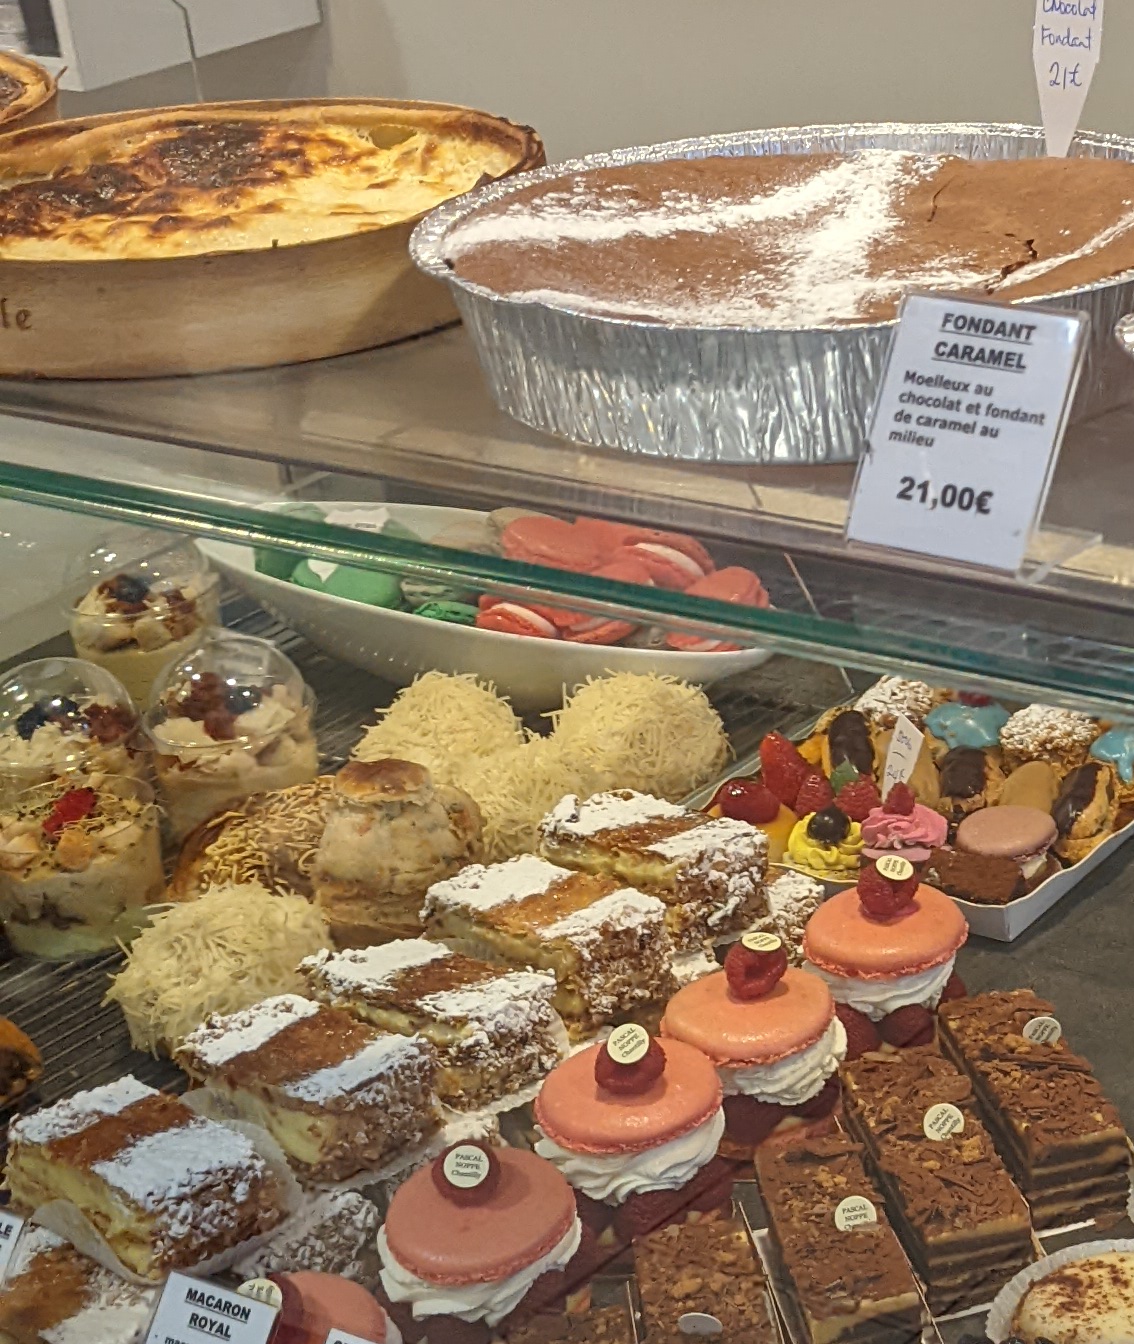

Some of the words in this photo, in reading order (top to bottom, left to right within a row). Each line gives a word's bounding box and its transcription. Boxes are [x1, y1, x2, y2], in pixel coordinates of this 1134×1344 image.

[1041, 24, 1092, 50] Fondant
[941, 312, 1037, 341] FONDANT
[934, 340, 1026, 369] CARAMEL
[903, 369, 970, 392] Moelleux
[973, 383, 993, 396] au
[898, 390, 962, 412] chocolat
[965, 402, 981, 416] et
[984, 402, 1045, 425] fondant
[893, 409, 912, 424] de
[915, 414, 976, 434] caramel
[979, 425, 999, 438] au
[888, 430, 934, 447] milieu
[896, 476, 993, 514] 21,00€
[613, 1028, 635, 1046] PASCAL
[618, 1034, 639, 1050] NOPPE
[455, 1153, 483, 1162] PASCAL
[455, 1161, 480, 1170] NOPPE
[185, 1287, 251, 1320] MACARON
[188, 1312, 231, 1338] ROYAL
